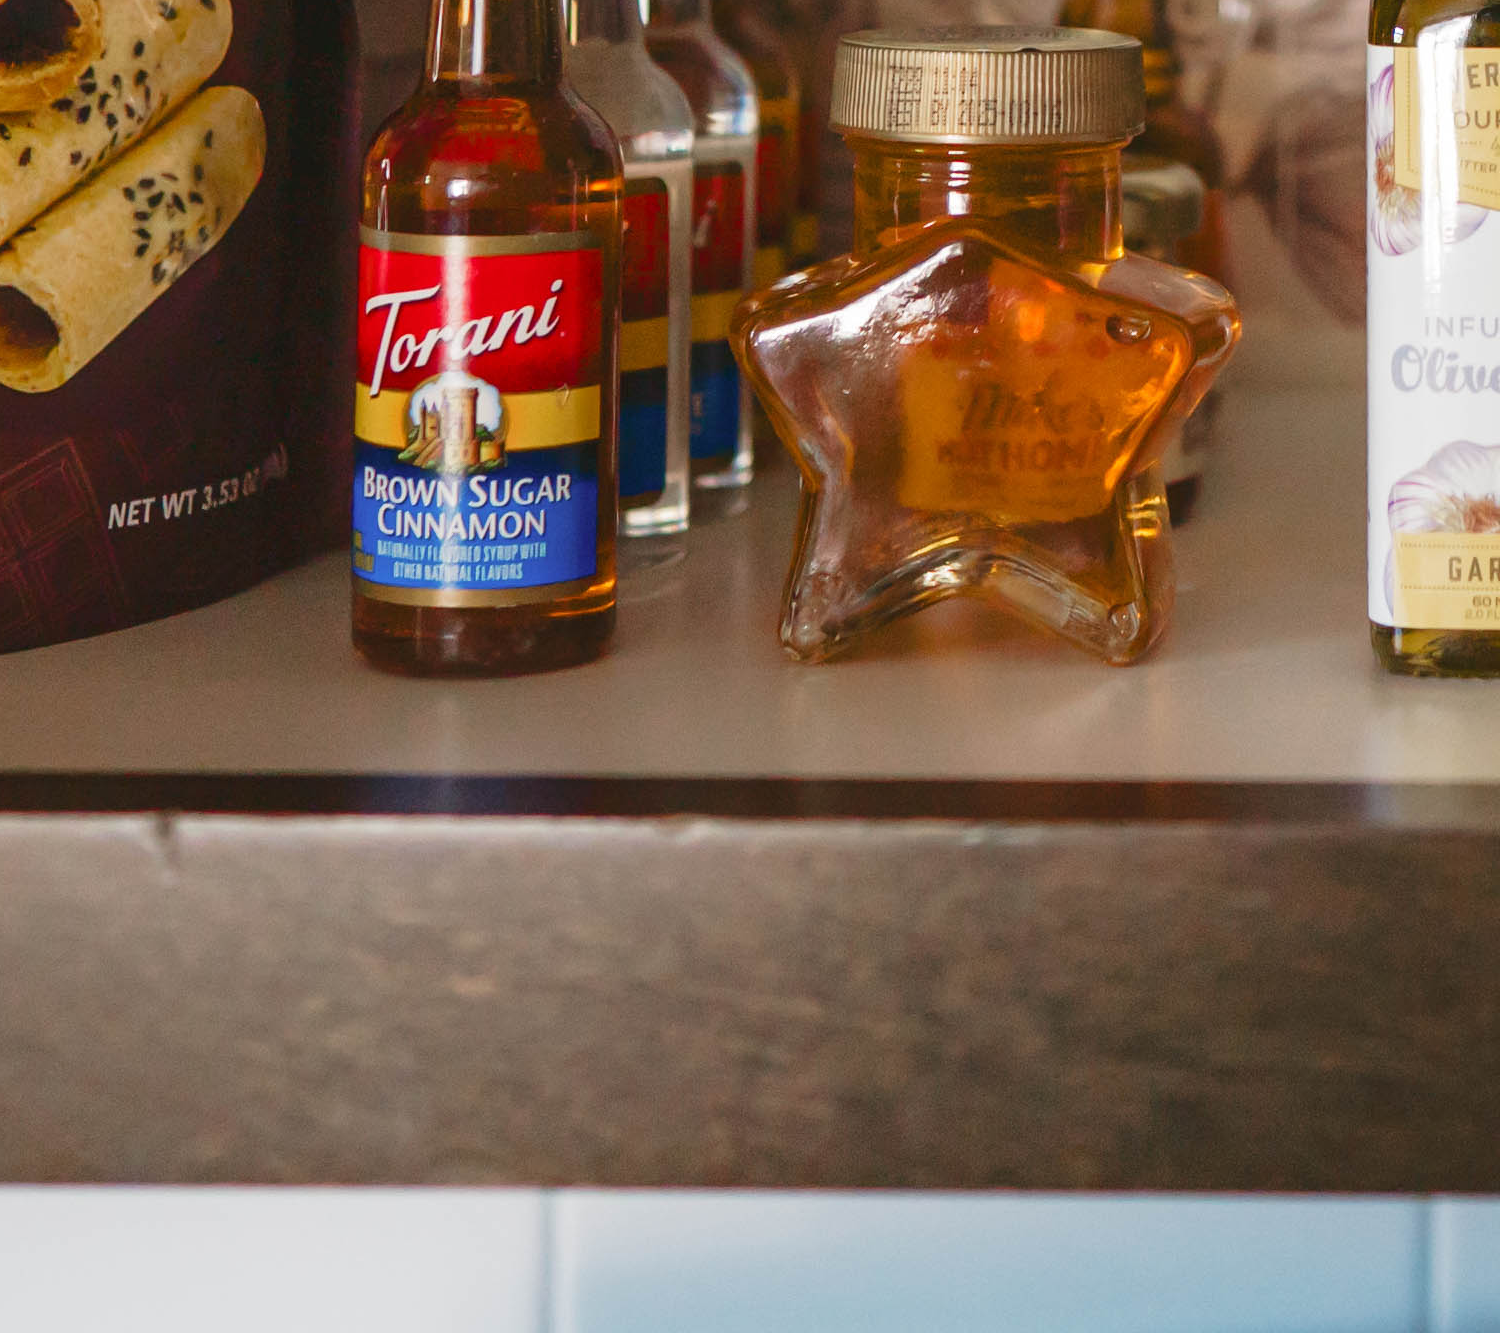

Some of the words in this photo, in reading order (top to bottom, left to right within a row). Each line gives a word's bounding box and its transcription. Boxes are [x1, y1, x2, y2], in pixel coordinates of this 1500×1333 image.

[365, 278, 563, 398] Torani
[108, 497, 156, 530] NET
[162, 488, 198, 520] WT
[202, 477, 240, 511] 3.53
[364, 465, 459, 507] BROWN
[468, 473, 572, 509] SUGAR
[377, 502, 546, 541] CINNAMON
[393, 561, 423, 580] OTHER
[520, 541, 547, 560] WITH
